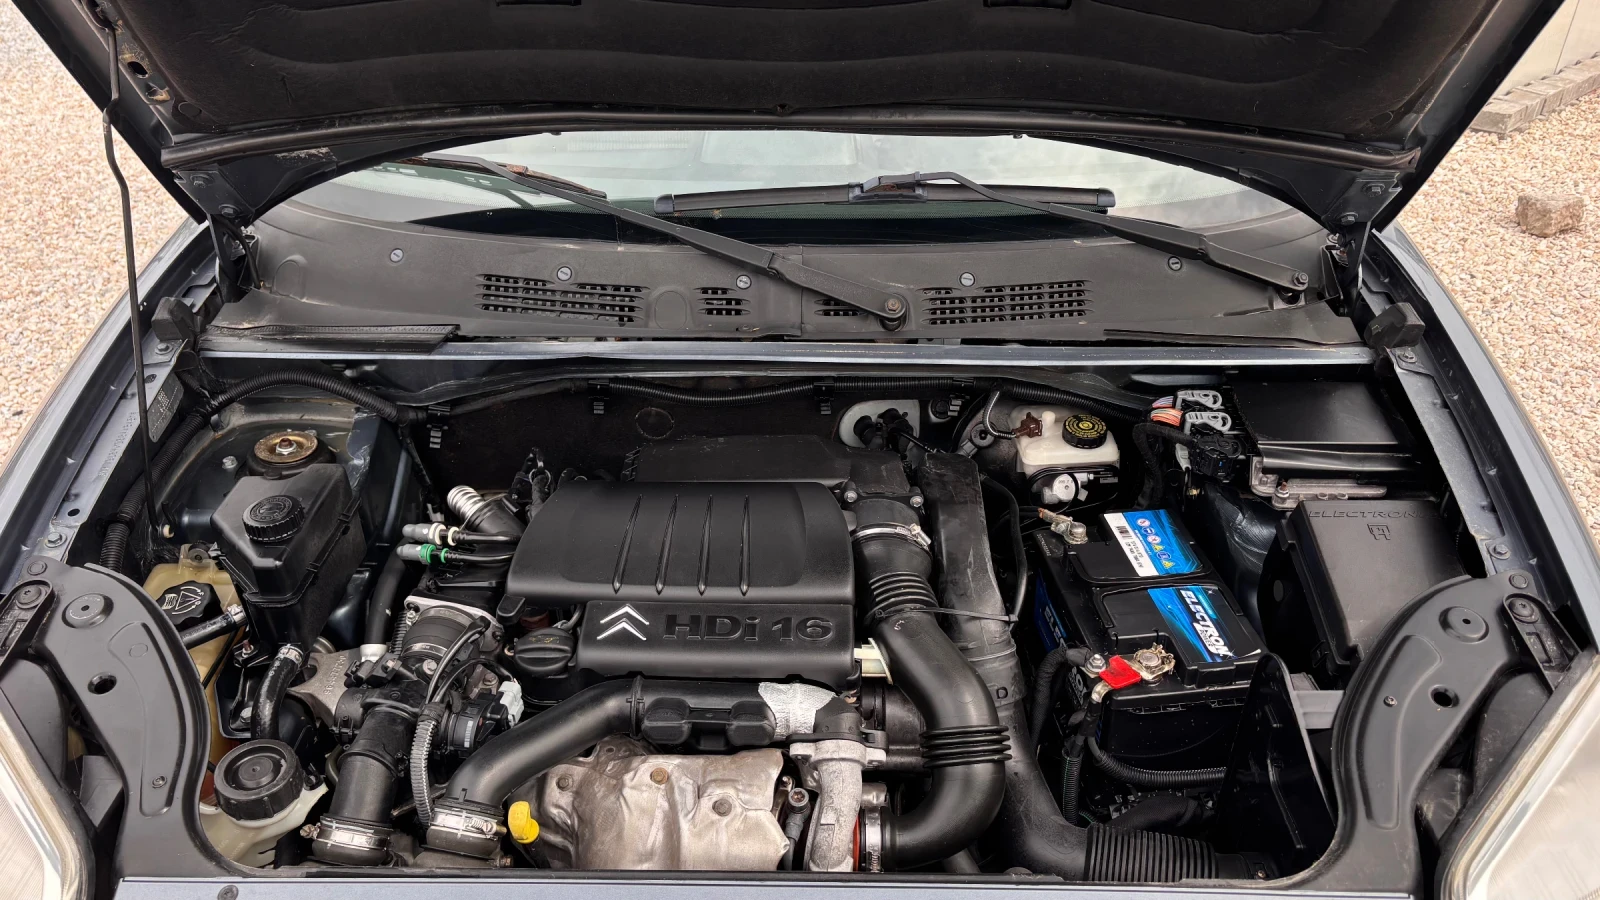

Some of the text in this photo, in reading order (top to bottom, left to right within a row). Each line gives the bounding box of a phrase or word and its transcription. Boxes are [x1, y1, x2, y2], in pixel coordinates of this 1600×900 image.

[663, 614, 836, 642] HDi 16
[1180, 589, 1238, 657] ELECTRON
